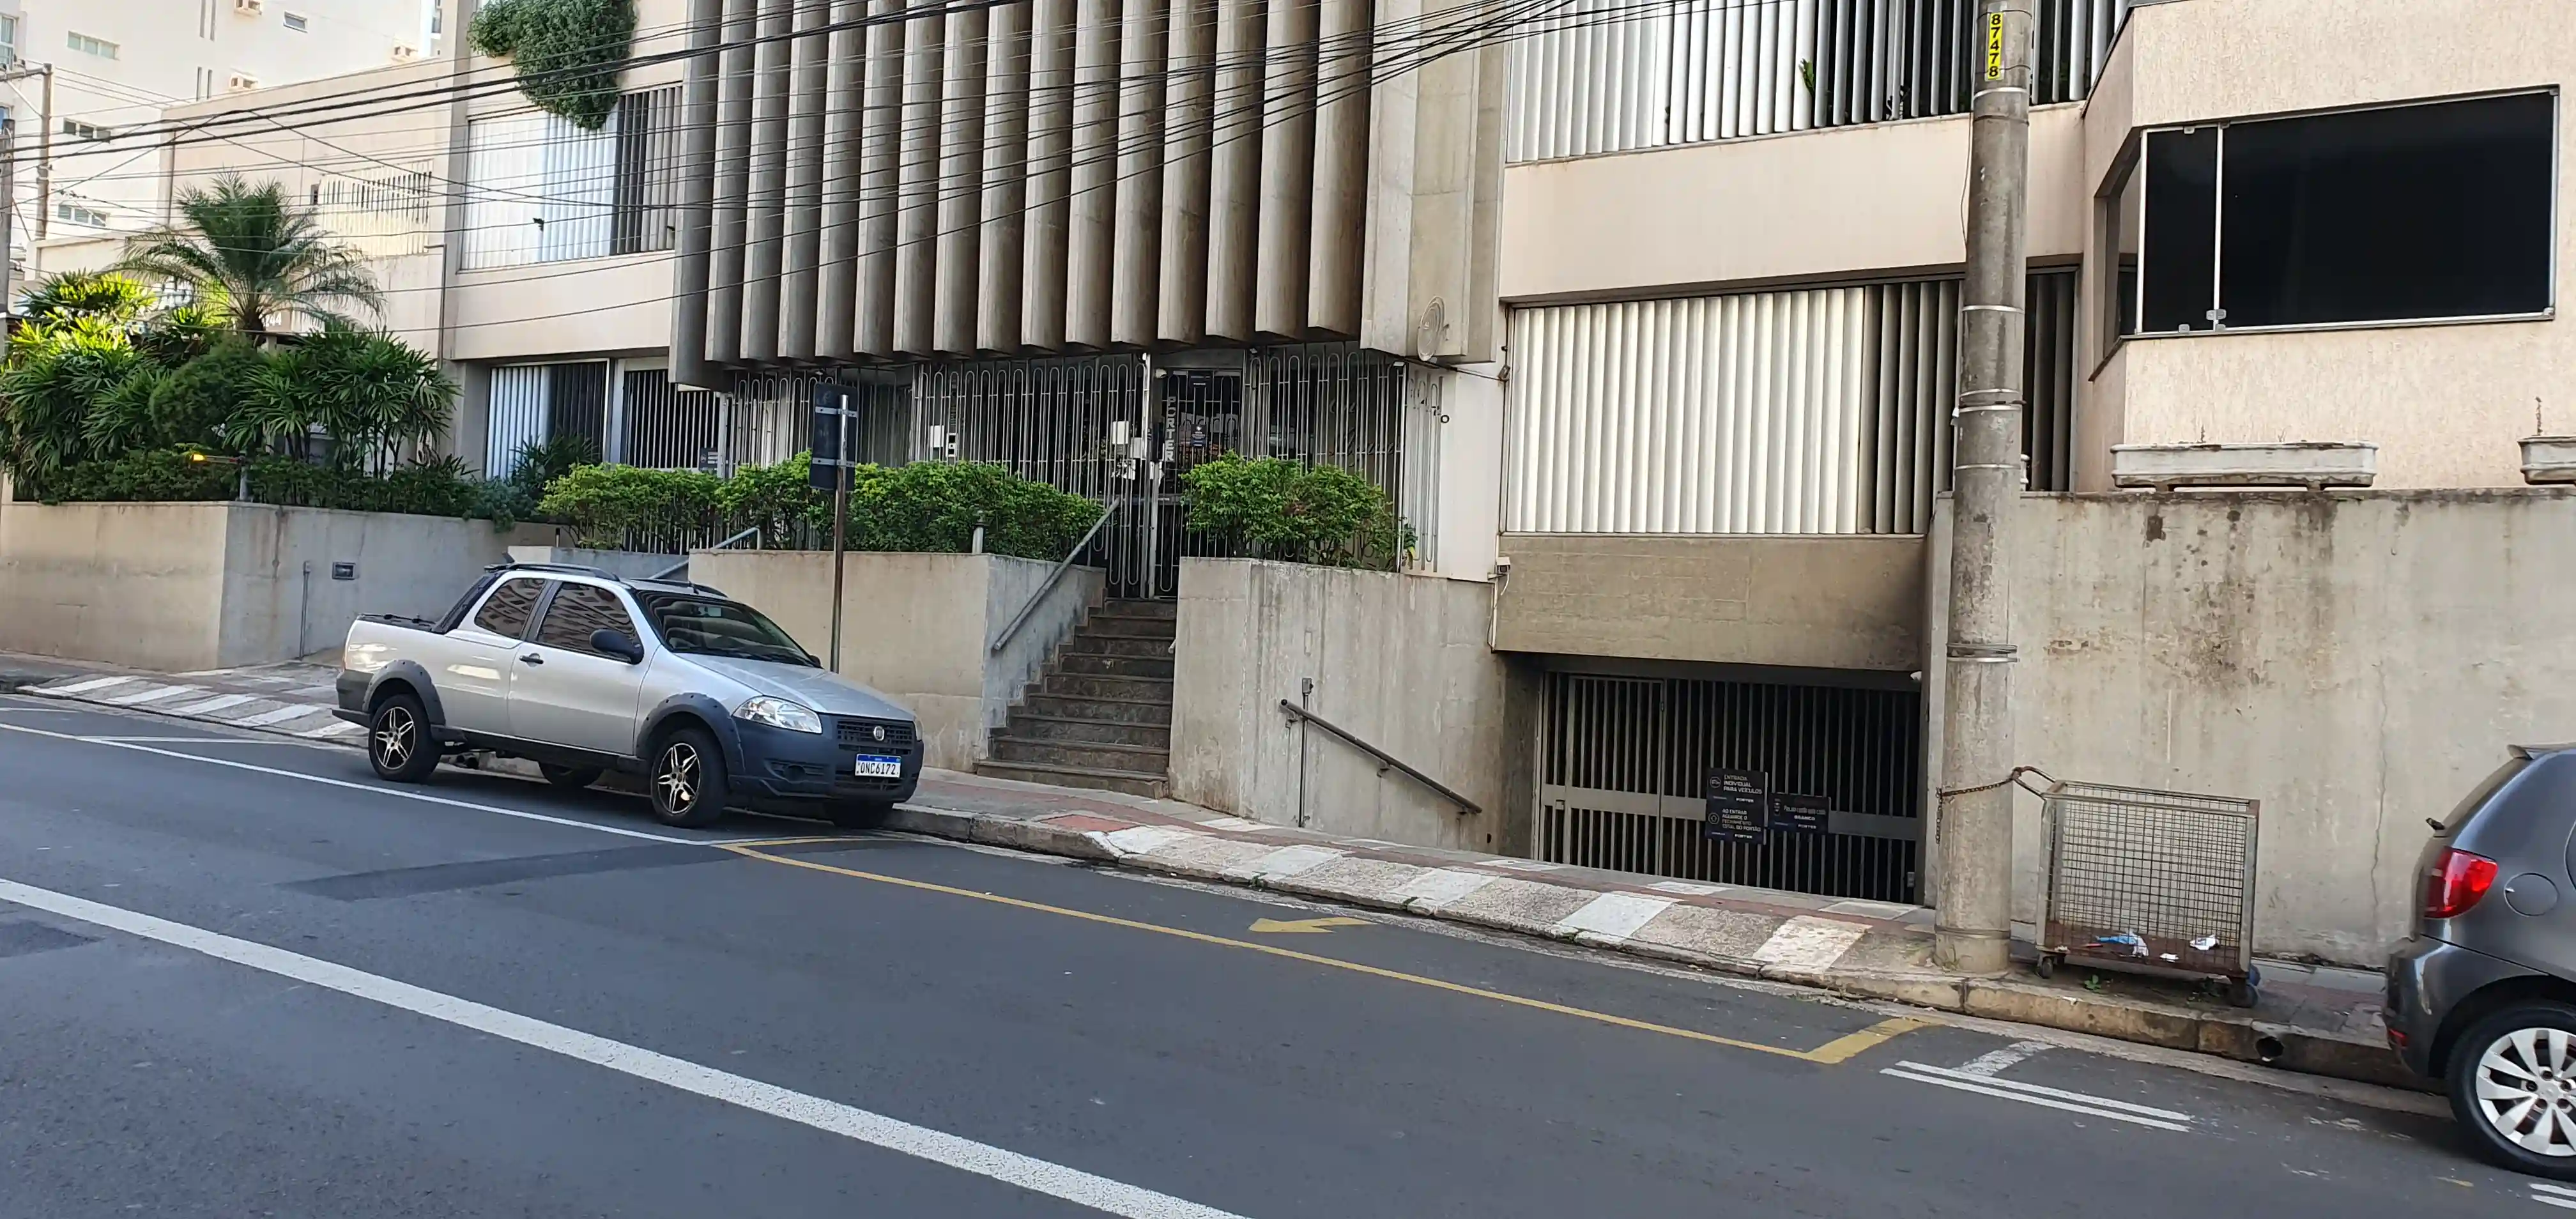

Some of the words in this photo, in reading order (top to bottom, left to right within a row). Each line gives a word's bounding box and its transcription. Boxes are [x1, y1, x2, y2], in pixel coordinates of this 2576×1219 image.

[1989, 14, 2001, 77] 87478
[1165, 396, 1177, 462] PORTER
[861, 762, 896, 775] ONC6172
